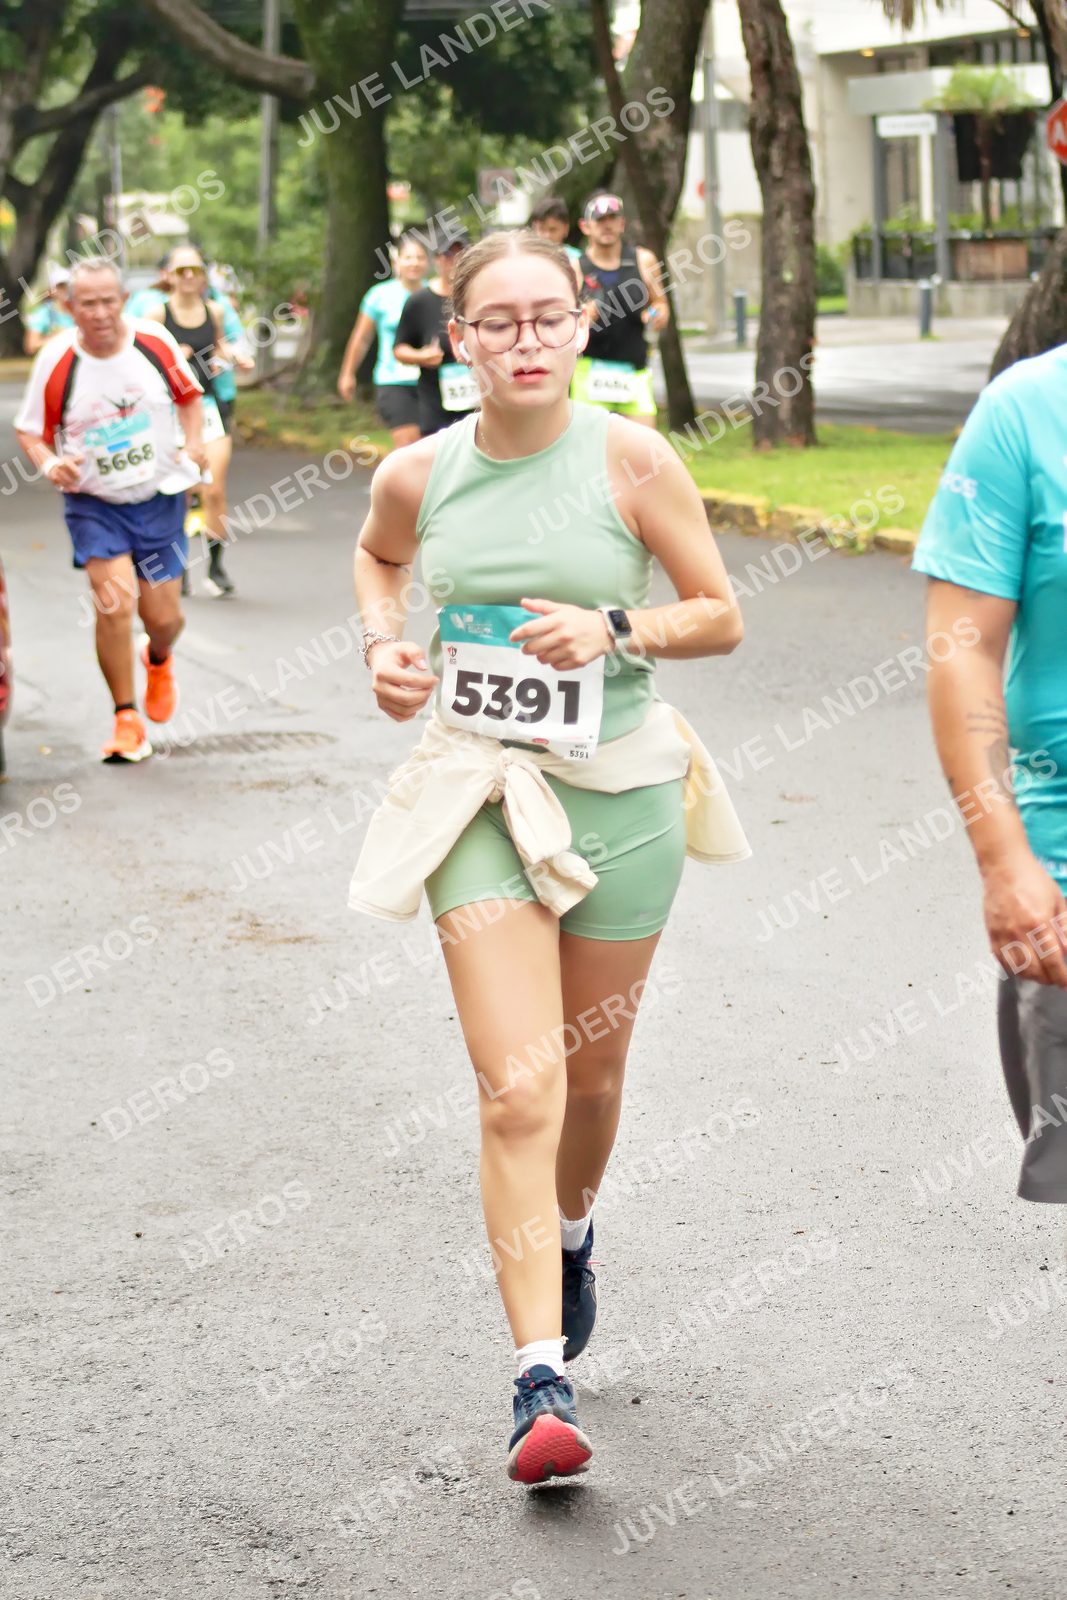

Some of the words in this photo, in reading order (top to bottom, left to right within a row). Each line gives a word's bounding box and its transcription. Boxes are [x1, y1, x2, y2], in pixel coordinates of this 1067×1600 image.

[96, 443, 154, 475] 5668
[452, 670, 580, 725] 5391
[569, 750, 589, 759] 5391
